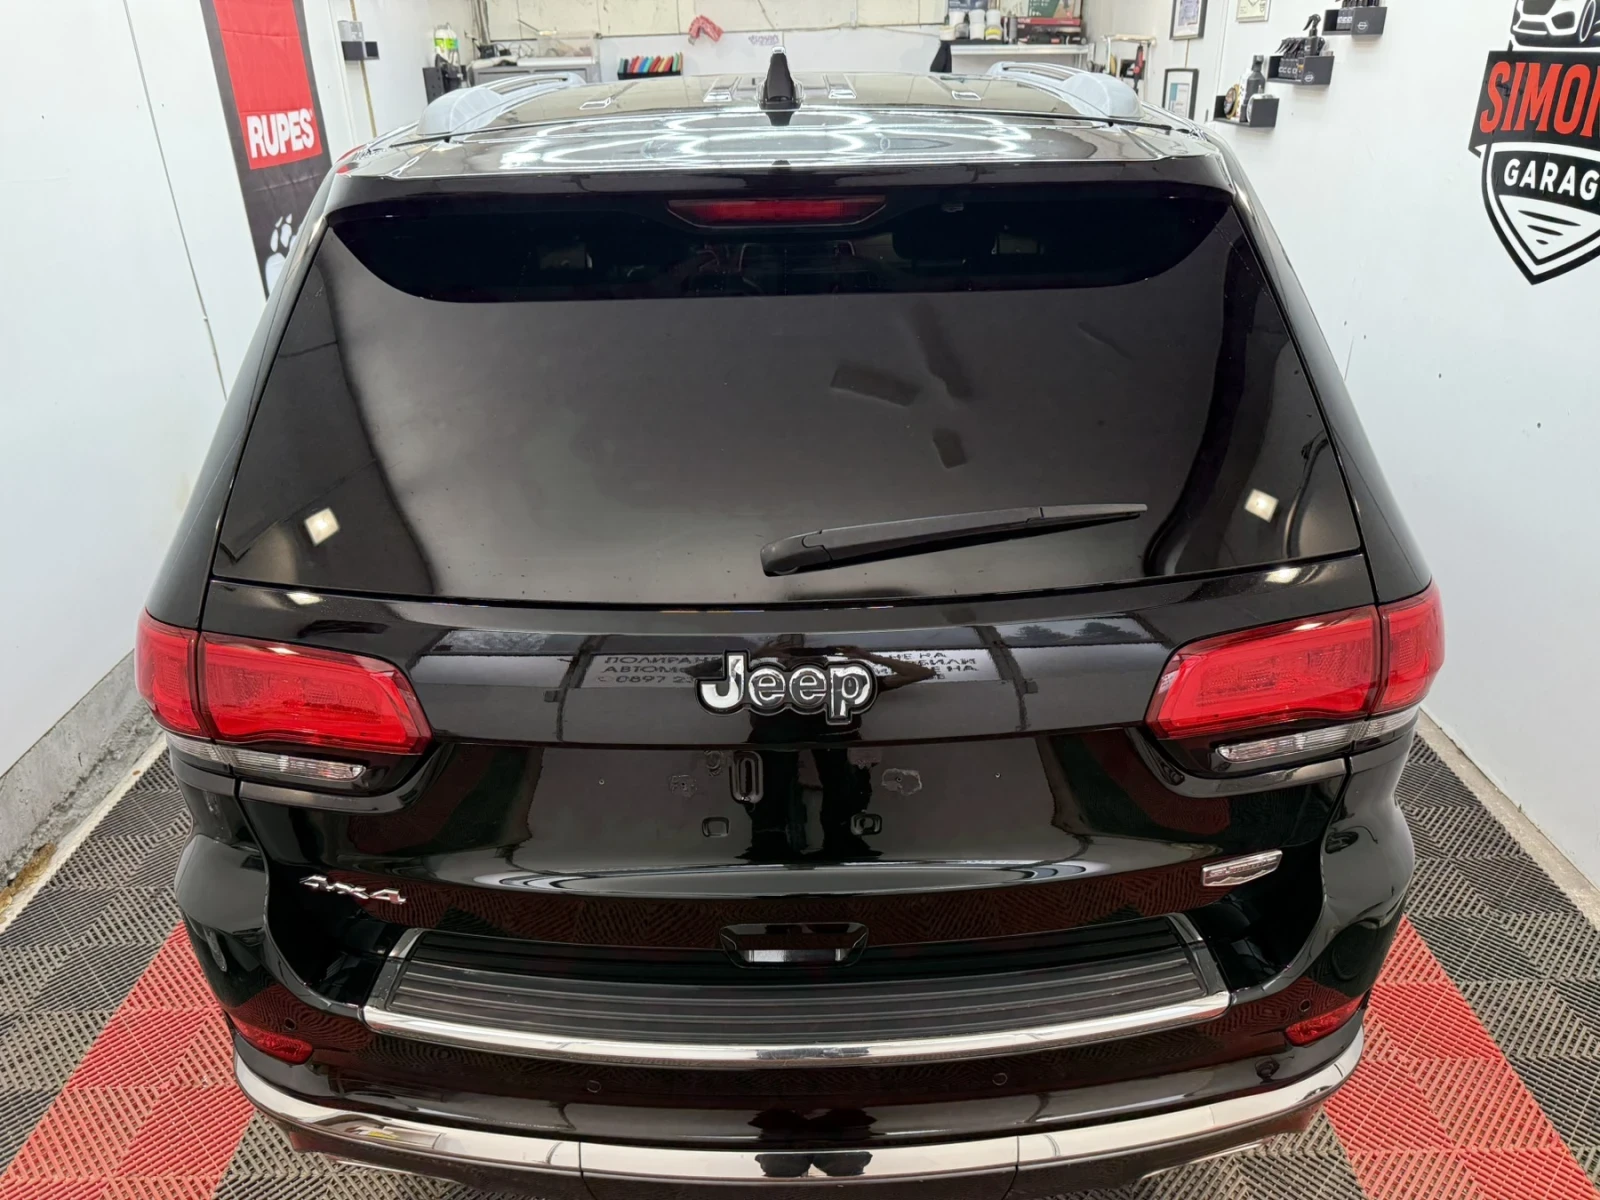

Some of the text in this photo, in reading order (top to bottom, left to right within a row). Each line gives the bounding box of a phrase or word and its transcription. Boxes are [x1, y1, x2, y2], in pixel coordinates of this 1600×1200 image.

[246, 108, 315, 158] RUPES
[1504, 158, 1600, 201] GARAG
[602, 665, 691, 674] АВТОМО
[701, 654, 873, 718] Jeep
